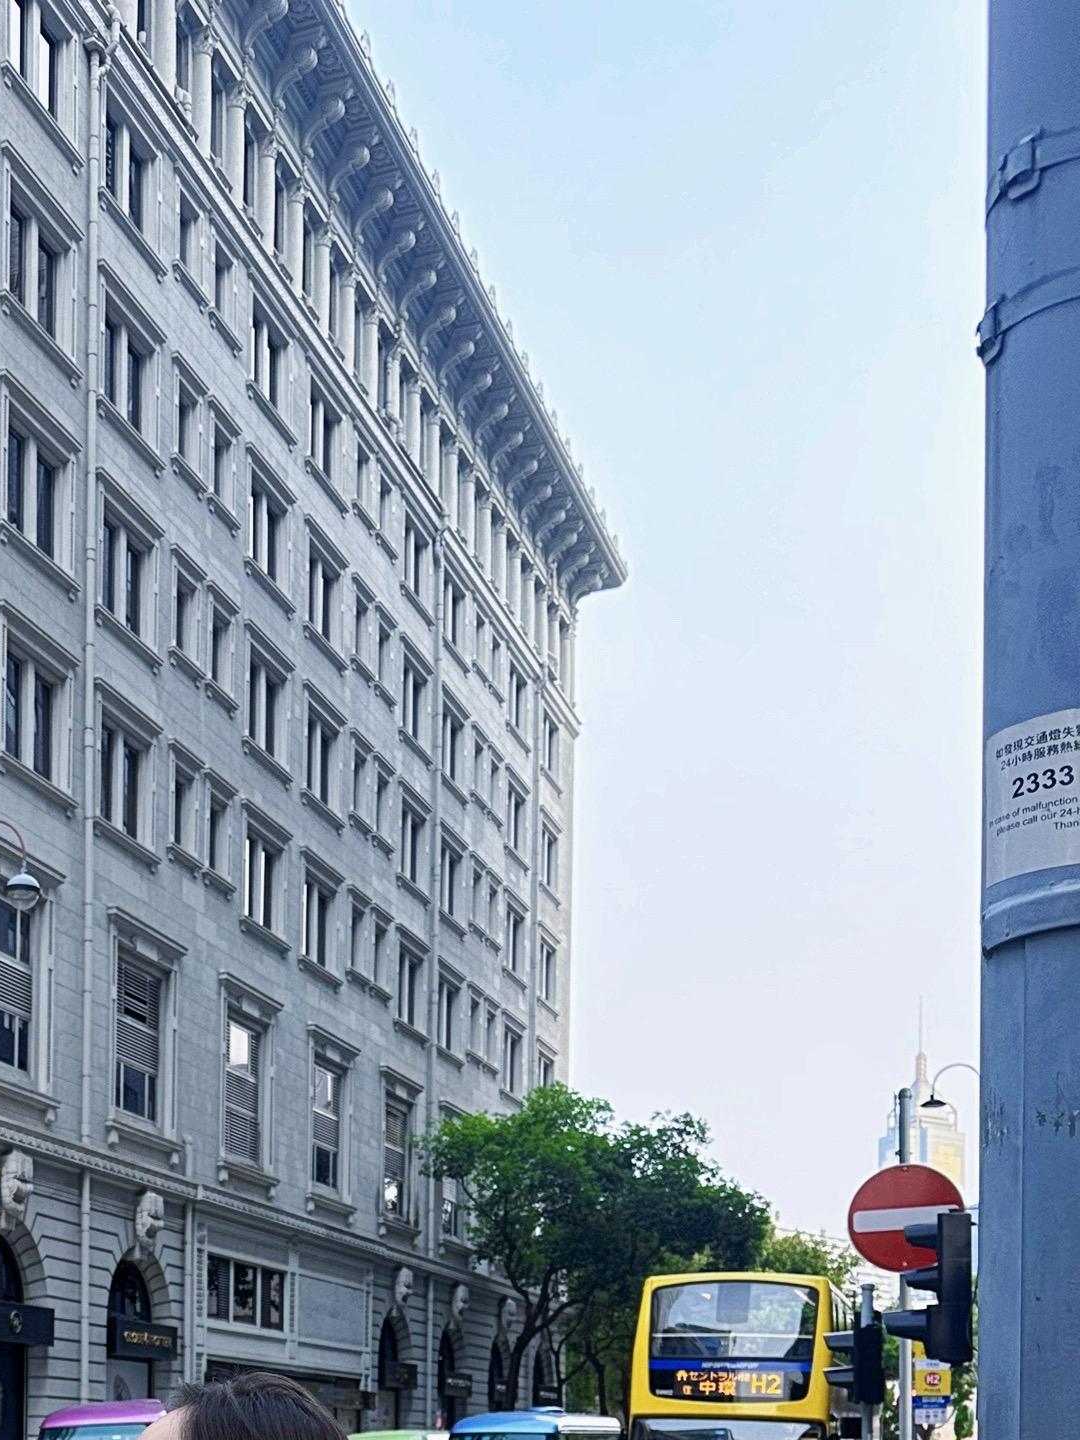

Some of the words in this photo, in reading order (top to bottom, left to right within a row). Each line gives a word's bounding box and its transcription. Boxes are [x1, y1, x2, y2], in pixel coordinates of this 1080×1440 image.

[1012, 765, 1075, 799] 2333
[1012, 806, 1020, 817] of
[1022, 796, 1078, 814] malfunction
[1022, 815, 1038, 826] call
[1040, 811, 1057, 821] our
[751, 1373, 783, 1395] H2
